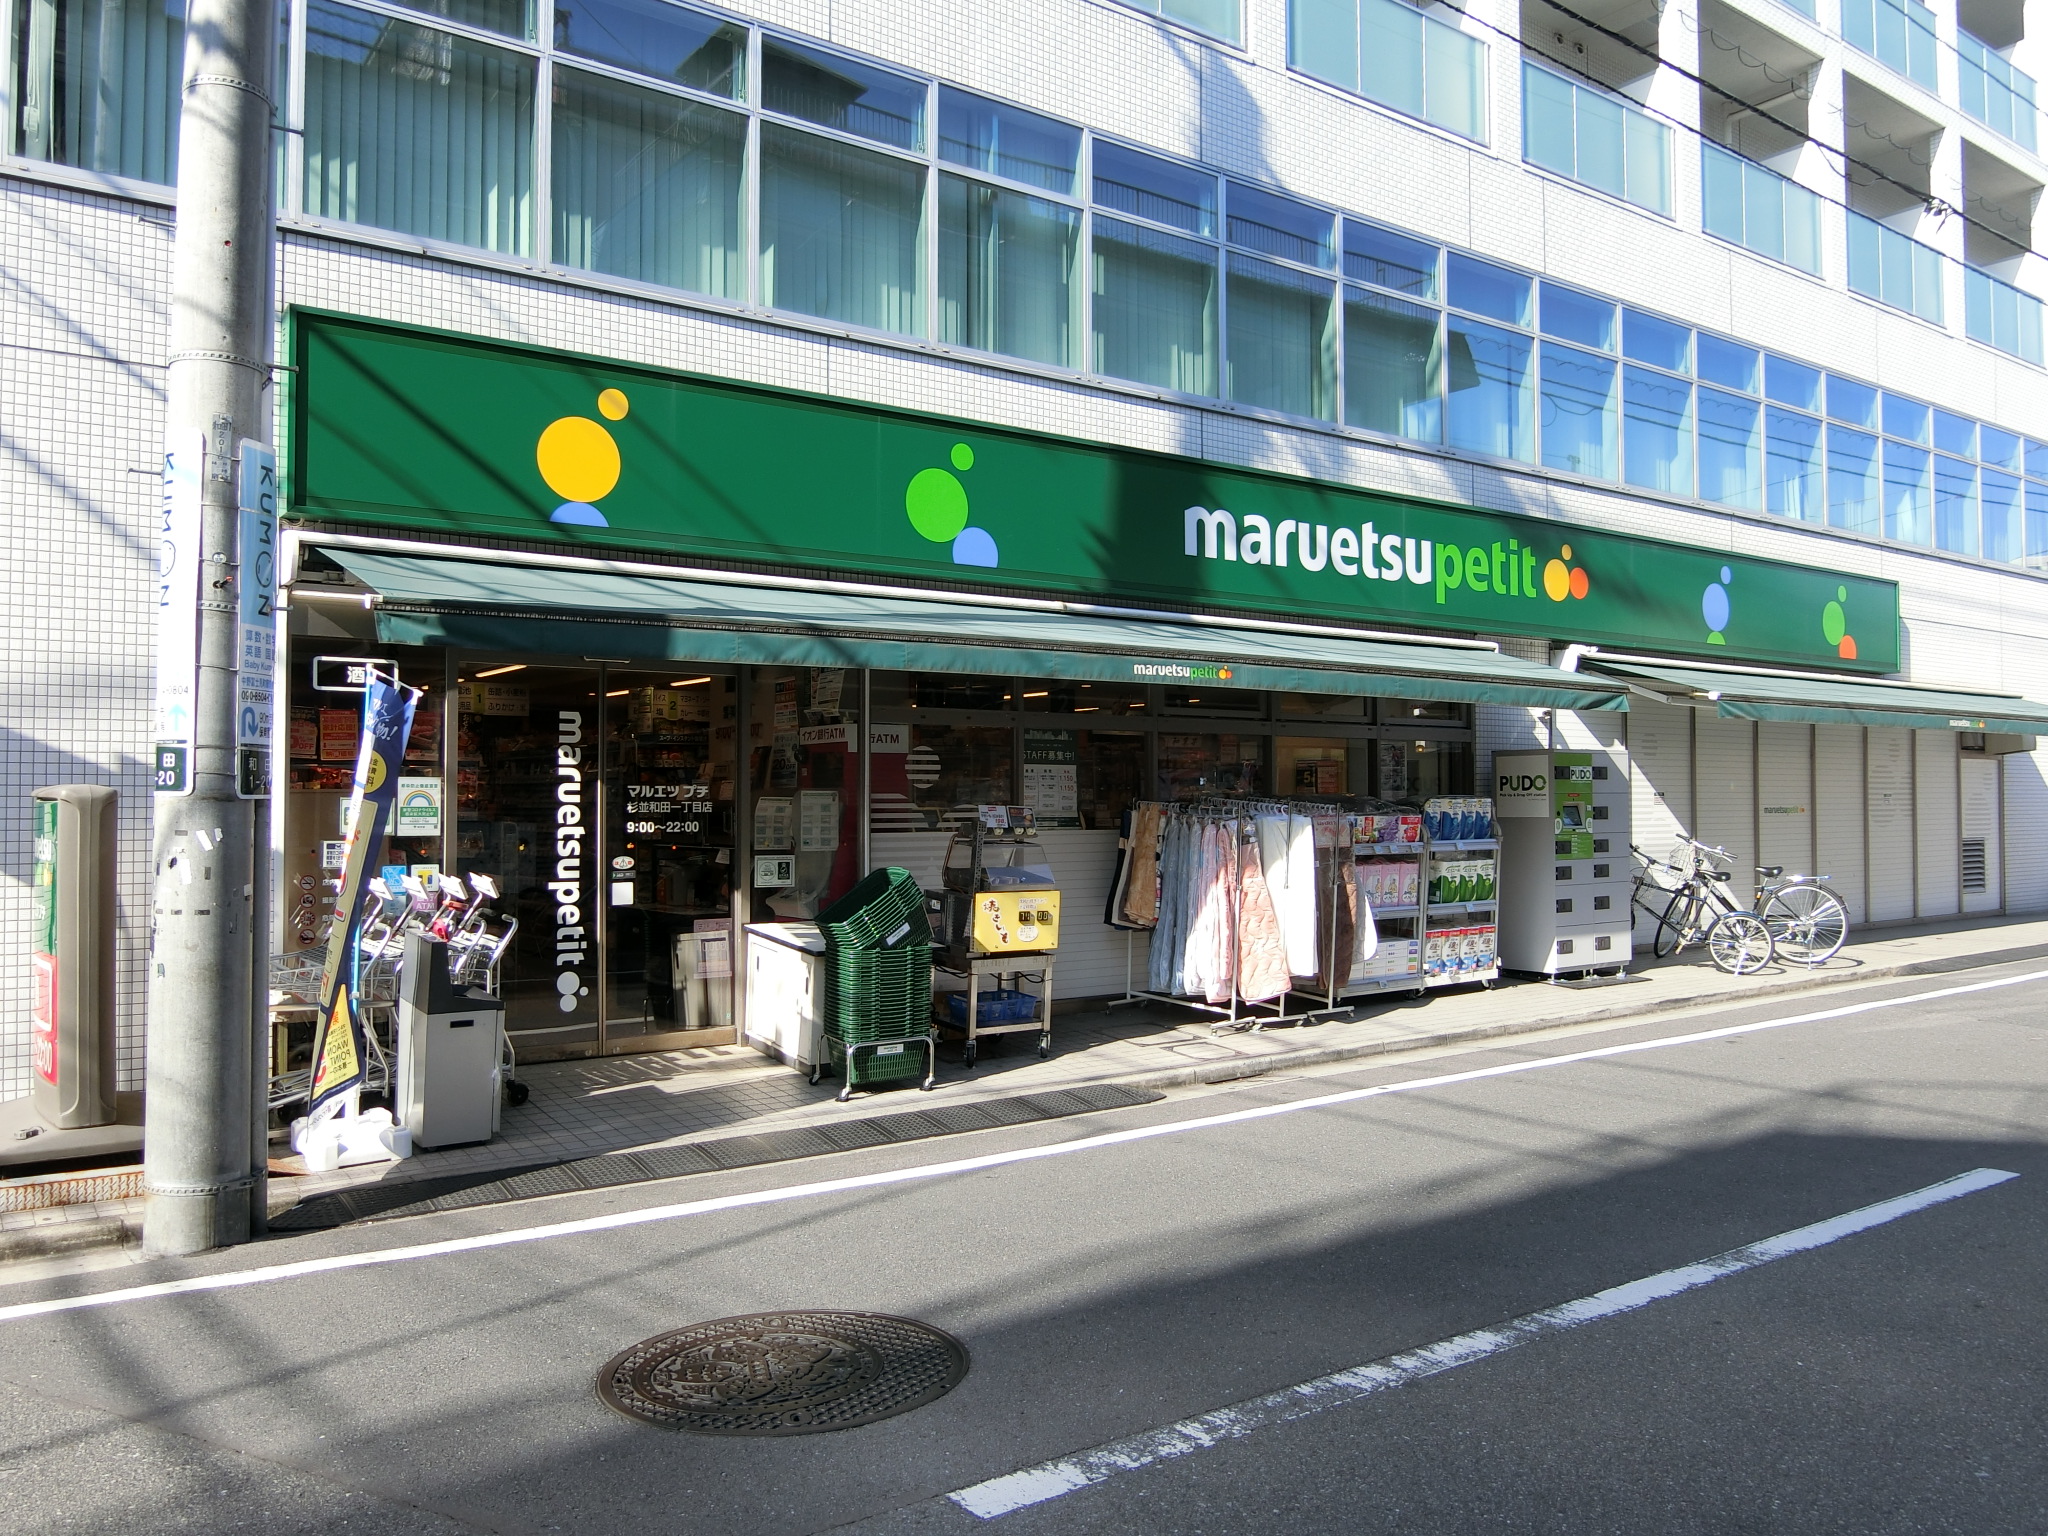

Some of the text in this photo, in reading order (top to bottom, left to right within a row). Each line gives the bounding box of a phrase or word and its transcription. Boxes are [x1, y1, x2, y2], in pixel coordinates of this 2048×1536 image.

[255, 465, 273, 617] KUMON
[245, 659, 260, 671] Baby
[477, 693, 482, 703] 1
[669, 700, 677, 711] 2
[801, 727, 846, 741] イオン銀行ATM
[1571, 769, 1592, 779] PUDO
[1499, 774, 1547, 791] PUDO
[627, 784, 709, 797] マルエツ プチ
[627, 801, 713, 813] 杉並和田一丁目店
[416, 902, 435, 910] ATM
